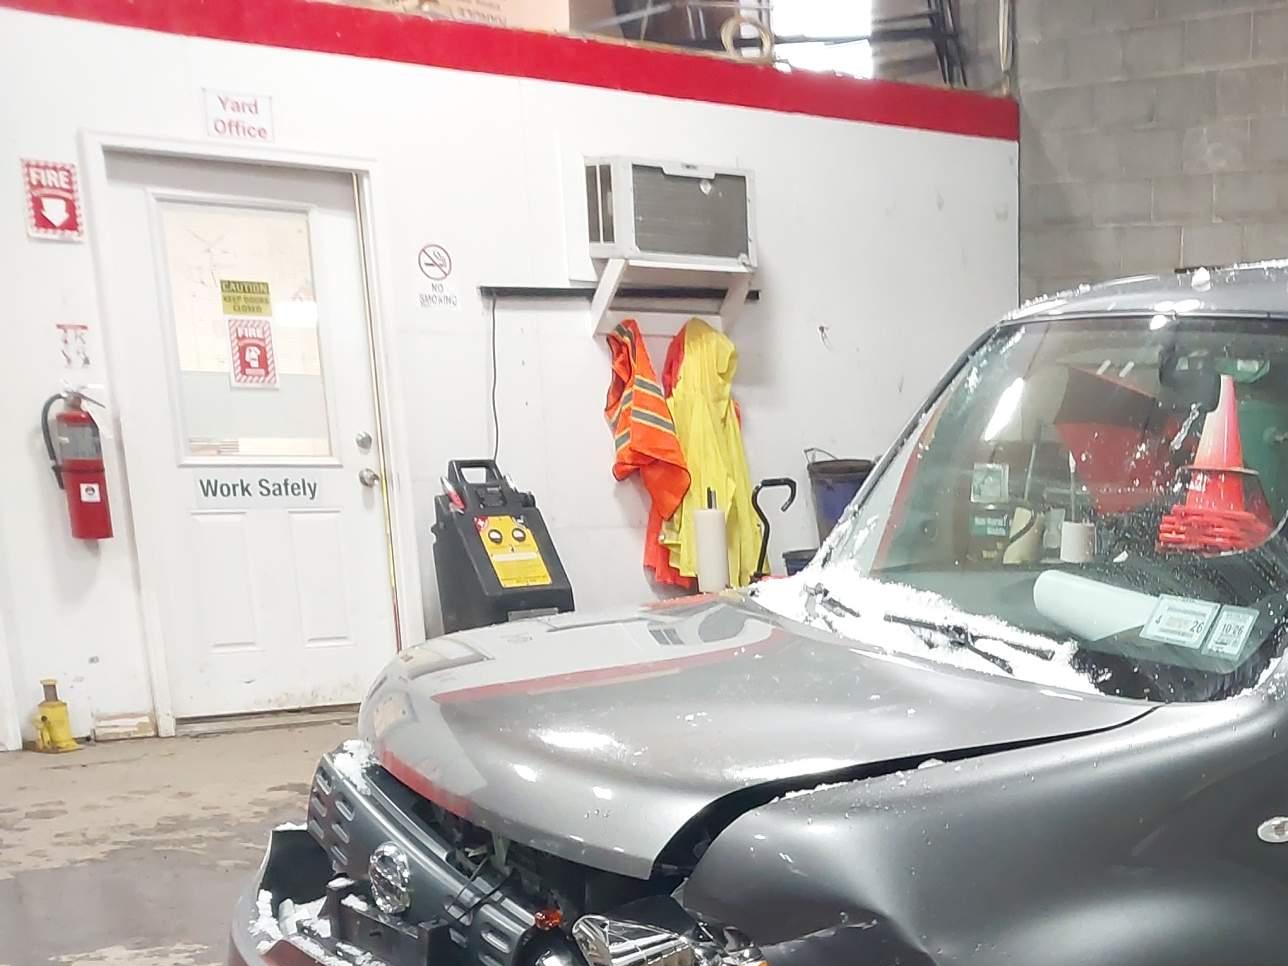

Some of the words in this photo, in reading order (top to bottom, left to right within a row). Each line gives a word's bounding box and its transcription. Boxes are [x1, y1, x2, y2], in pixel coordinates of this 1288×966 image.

[217, 95, 259, 115] Yard
[213, 118, 269, 140] Office
[29, 168, 72, 190] FIRE
[221, 281, 269, 295] CAUTION
[431, 282, 445, 293] NO
[419, 293, 458, 306] SMOKING
[199, 478, 253, 498] Work
[258, 477, 318, 501] Safely
[1190, 619, 1205, 634] 26
